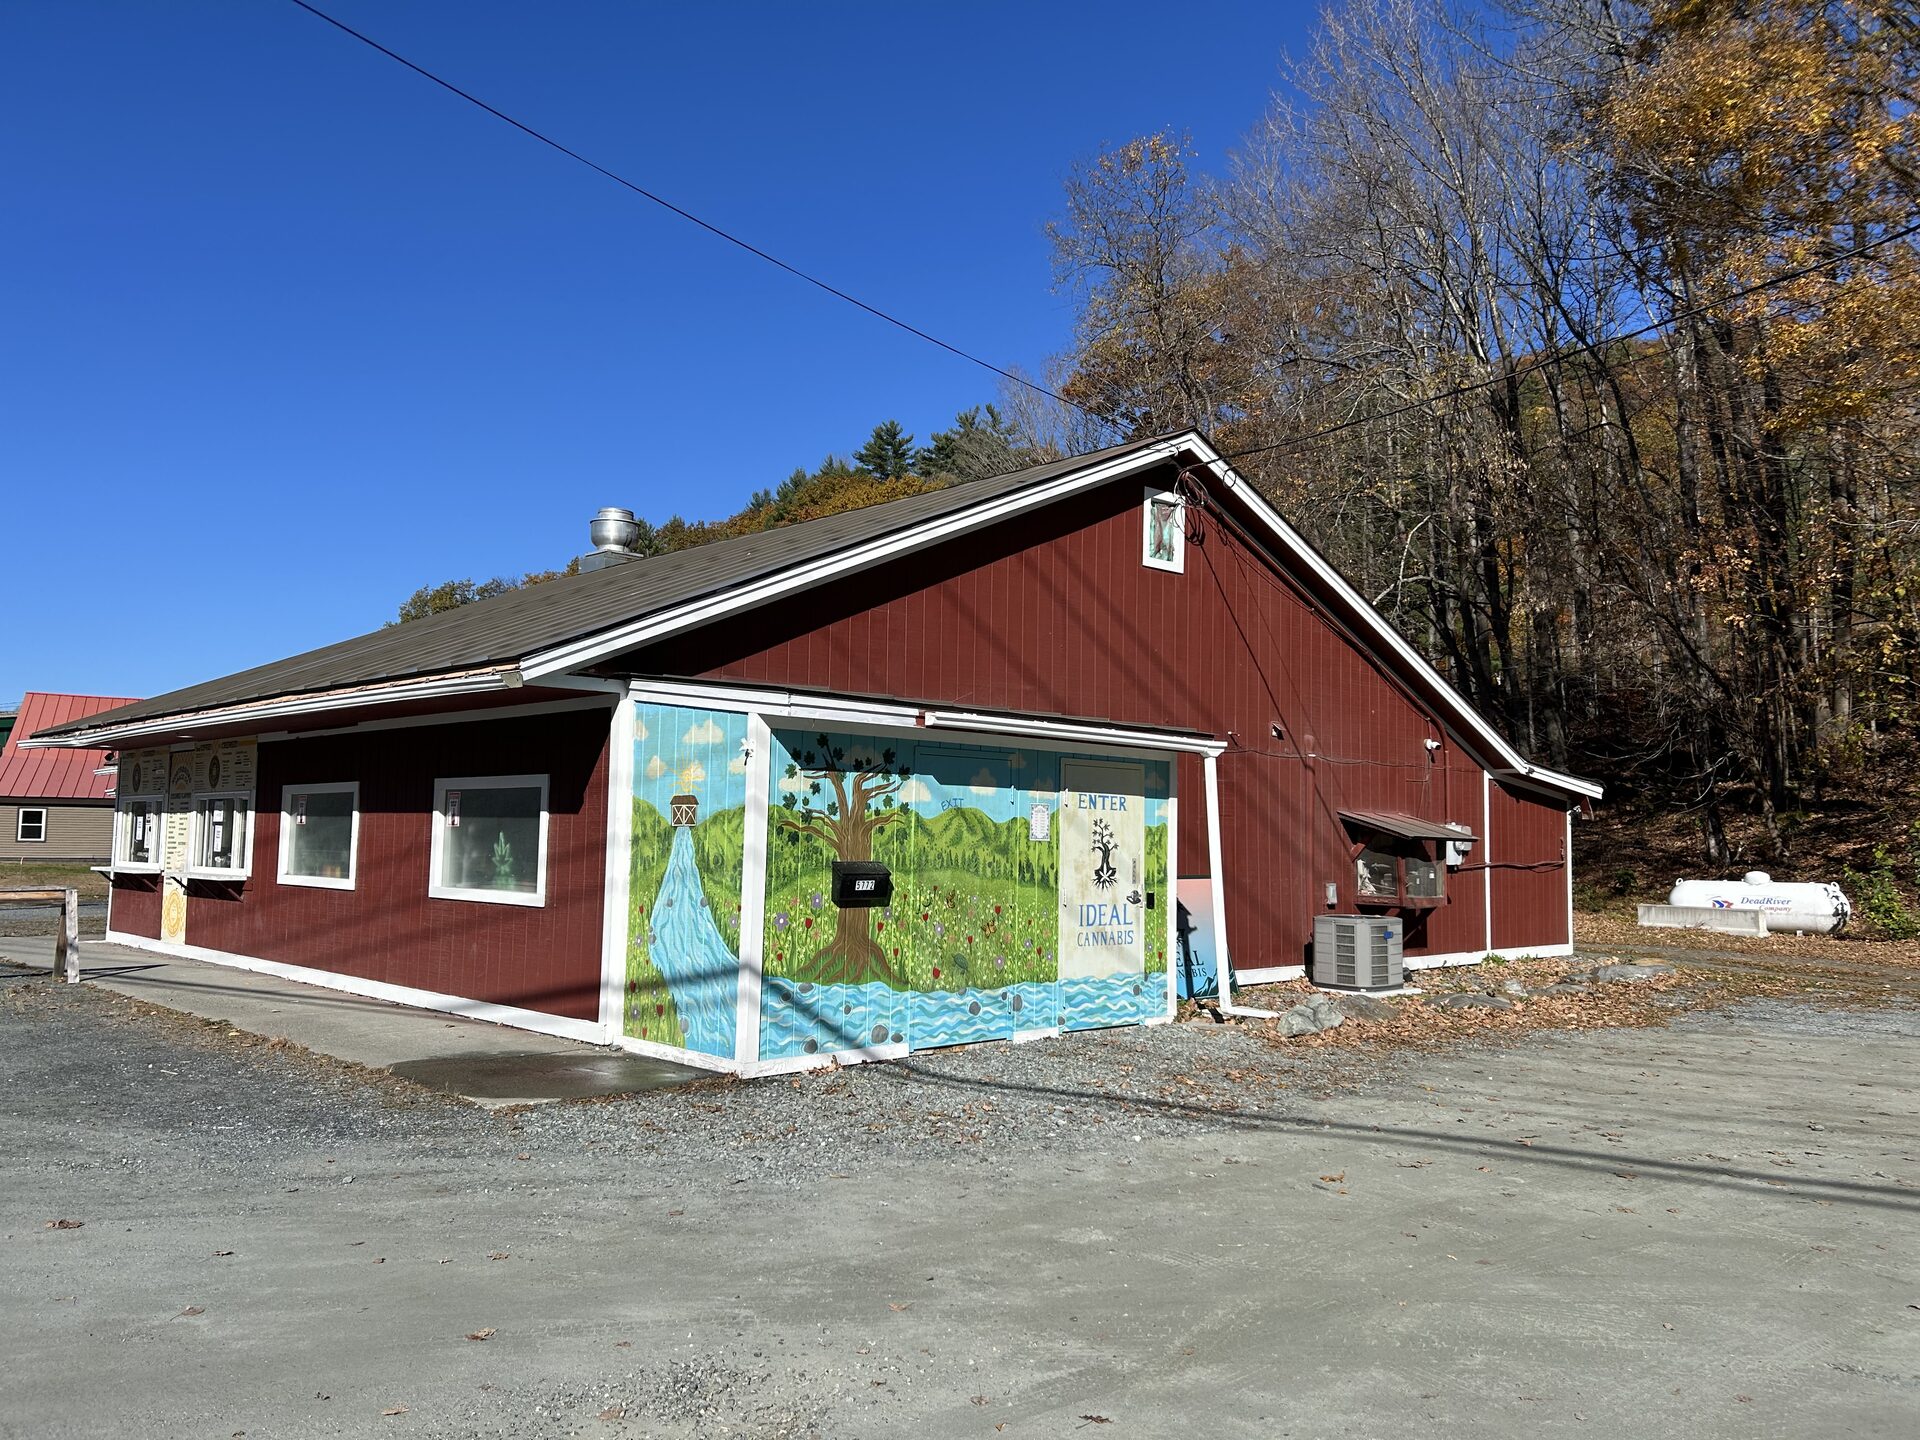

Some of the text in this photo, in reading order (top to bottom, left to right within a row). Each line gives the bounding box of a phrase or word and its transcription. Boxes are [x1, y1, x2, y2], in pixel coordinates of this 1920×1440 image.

[941, 797, 964, 811] EXIT
[1078, 793, 1127, 811] ENTER
[856, 880, 874, 890] 5772
[1079, 903, 1133, 927] IDEAL
[1077, 930, 1134, 947] CANNABIS
